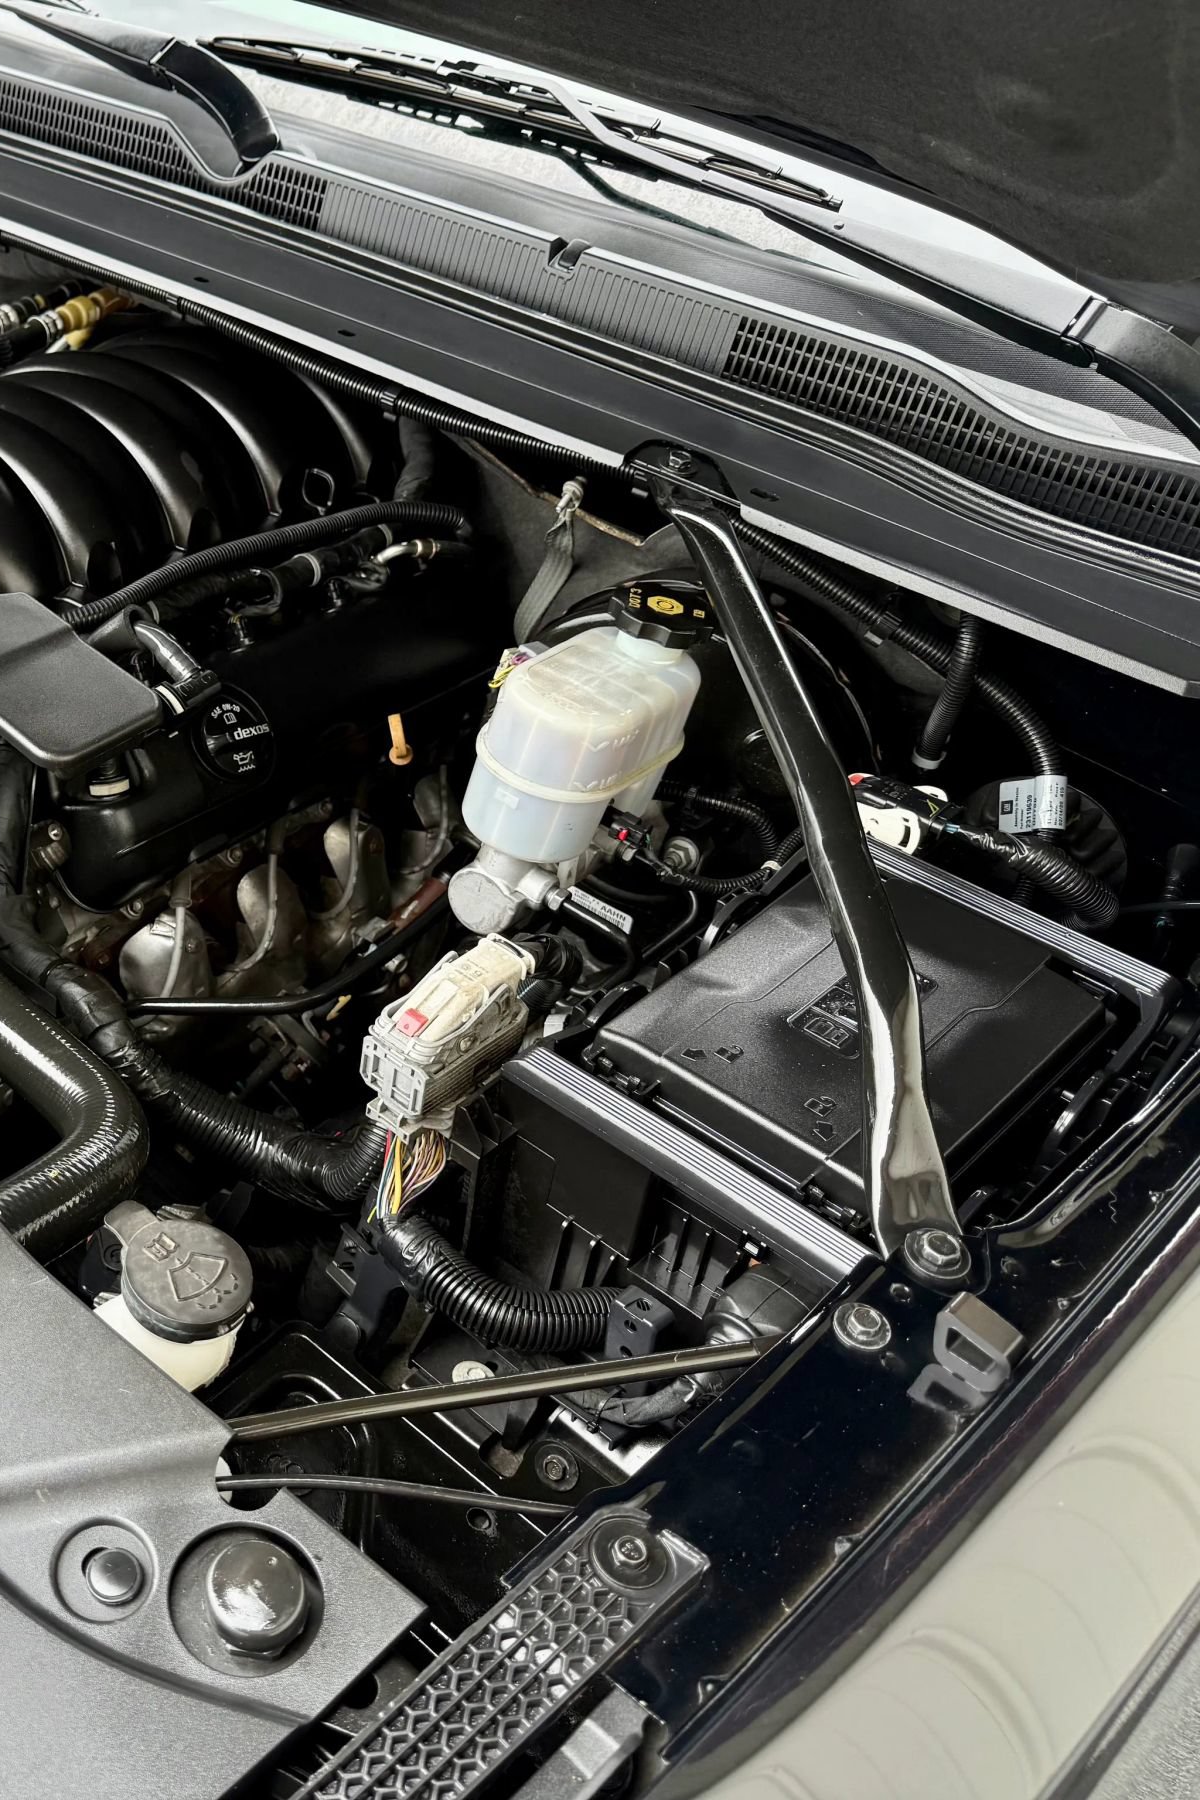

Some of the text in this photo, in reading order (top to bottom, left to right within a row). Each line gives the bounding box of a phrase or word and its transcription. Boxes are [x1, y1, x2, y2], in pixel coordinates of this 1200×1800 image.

[628, 592, 641, 609] DOT
[211, 706, 222, 719] SAE
[233, 723, 270, 741] dexos
[600, 905, 626, 922] AAHN
